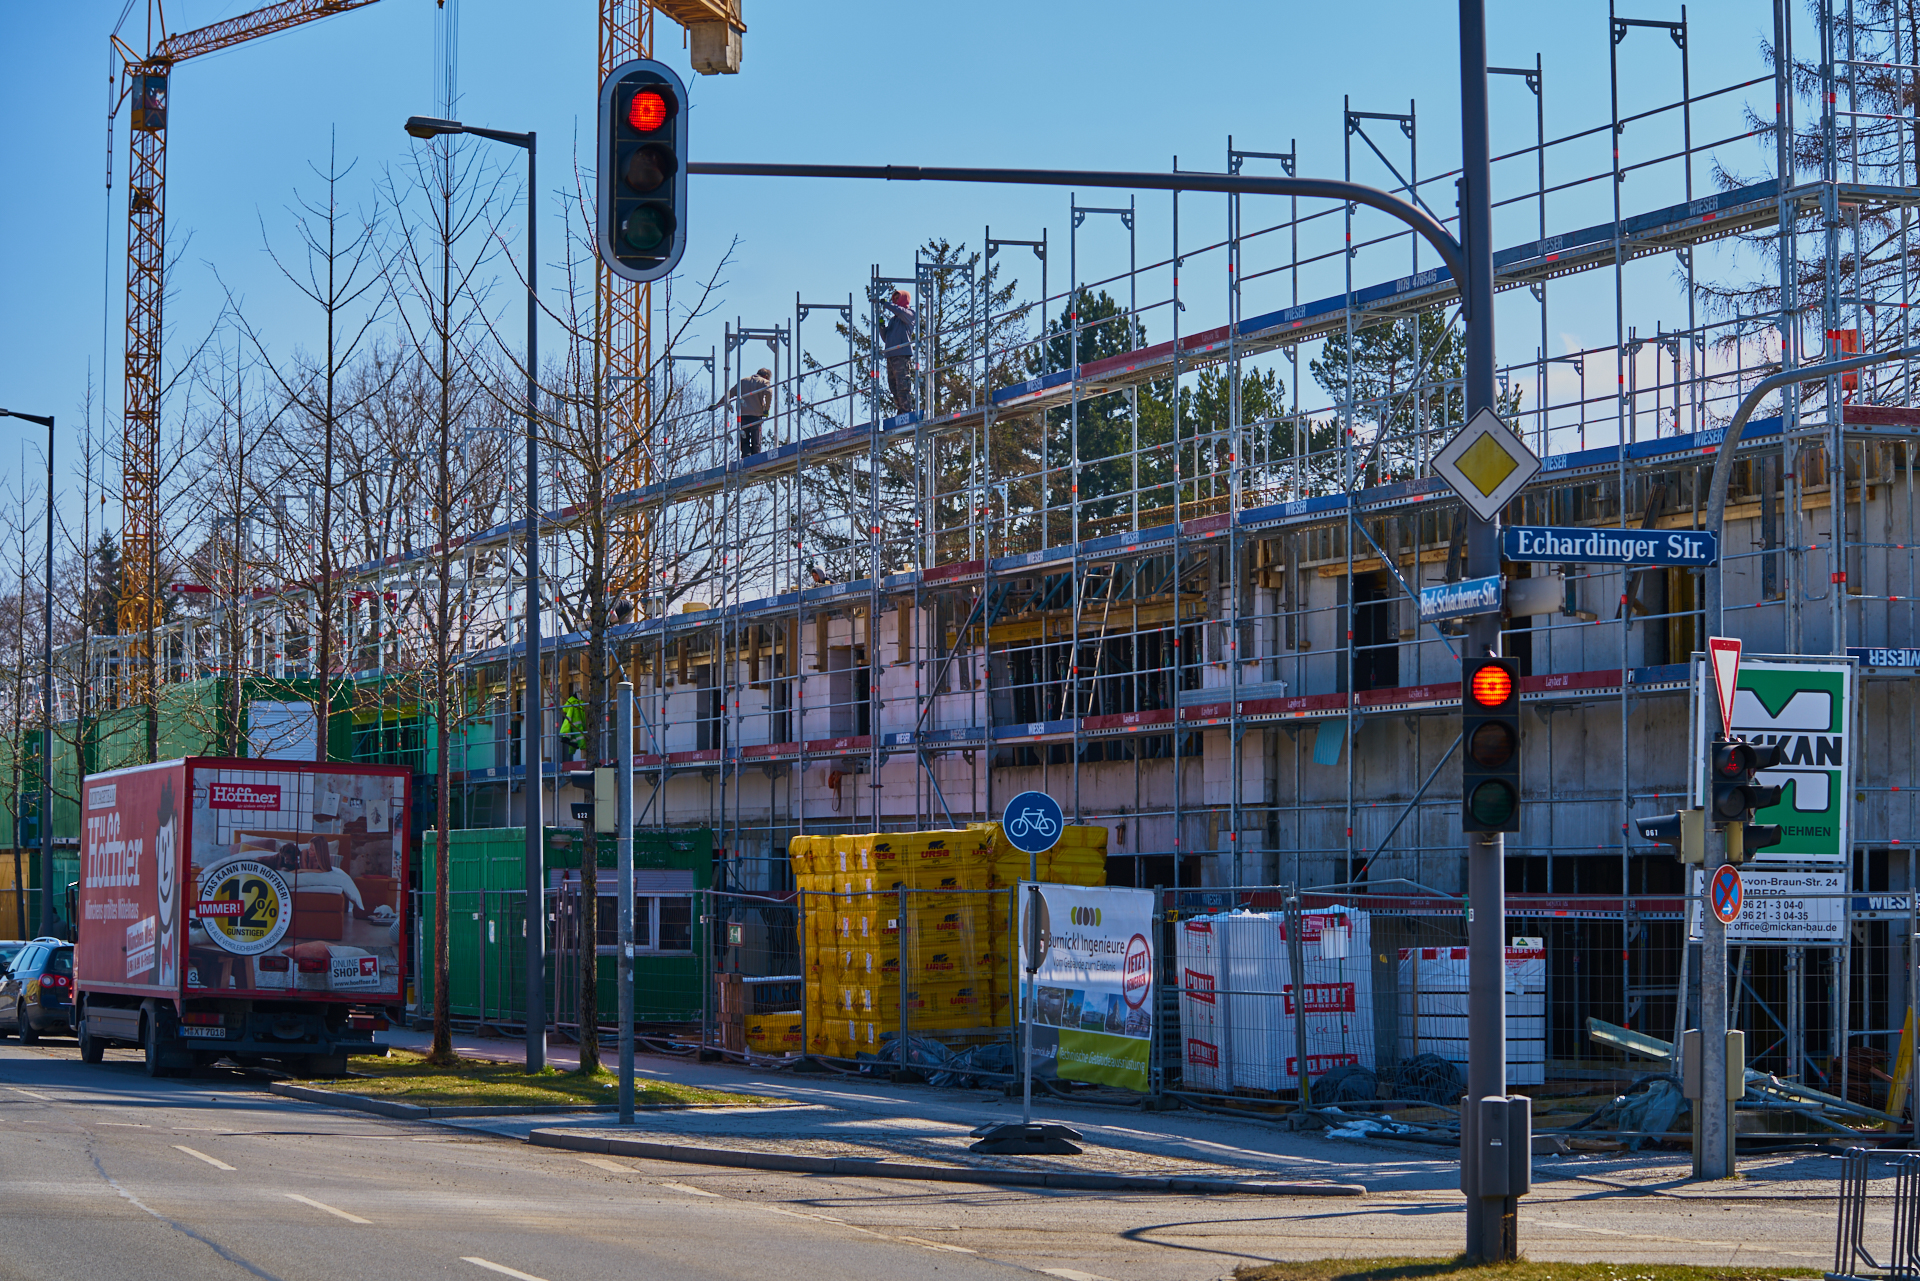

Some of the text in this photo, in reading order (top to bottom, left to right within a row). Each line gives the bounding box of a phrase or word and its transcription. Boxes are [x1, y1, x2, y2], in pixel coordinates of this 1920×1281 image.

[1688, 196, 1719, 216] WIESER
[1536, 236, 1563, 254] WIESER
[1396, 278, 1409, 292] 0179
[1284, 305, 1306, 322] WIESER
[1026, 378, 1044, 392] WIESER
[895, 413, 910, 426] WIESER
[1694, 428, 1724, 447] WIESER
[1540, 454, 1567, 473] WIESER
[1286, 500, 1307, 516] WIESER
[1120, 532, 1140, 546] WIESER
[1517, 530, 1706, 561] Echardinger Str.
[1026, 550, 1044, 564] WIESER
[1420, 581, 1498, 617] Bad-Schachener-Str.
[1028, 722, 1045, 734] WIESER
[896, 732, 910, 744] WIESER
[212, 786, 278, 804] Höffner
[86, 812, 144, 888] Höffner
[204, 863, 288, 900] DAS KANN NUR HÖFFNER!
[1826, 878, 1838, 886] 24
[199, 903, 240, 914] IMMER!
[1742, 901, 1754, 909] 96
[1756, 901, 1766, 909] 21
[1776, 901, 1781, 909] 3
[1784, 901, 1803, 909] 04-0
[226, 928, 264, 936] GÜNSTIGER
[1734, 922, 1837, 932] office@mickan-bau.de
[206, 921, 285, 952] ALS ALLE VERGLEICHBAREN ANGEBOTE
[1081, 935, 1124, 957] Ingenieure
[333, 958, 358, 968] ONLINE
[1054, 957, 1064, 967] Vom
[1064, 958, 1084, 970] Gebäude
[1084, 961, 1097, 970] zum
[1127, 950, 1146, 974] JETZT
[334, 968, 359, 978] SHOP
[184, 1028, 190, 1036] M
[206, 1028, 225, 1036] 7018
[1060, 1046, 1088, 1064] Technische
